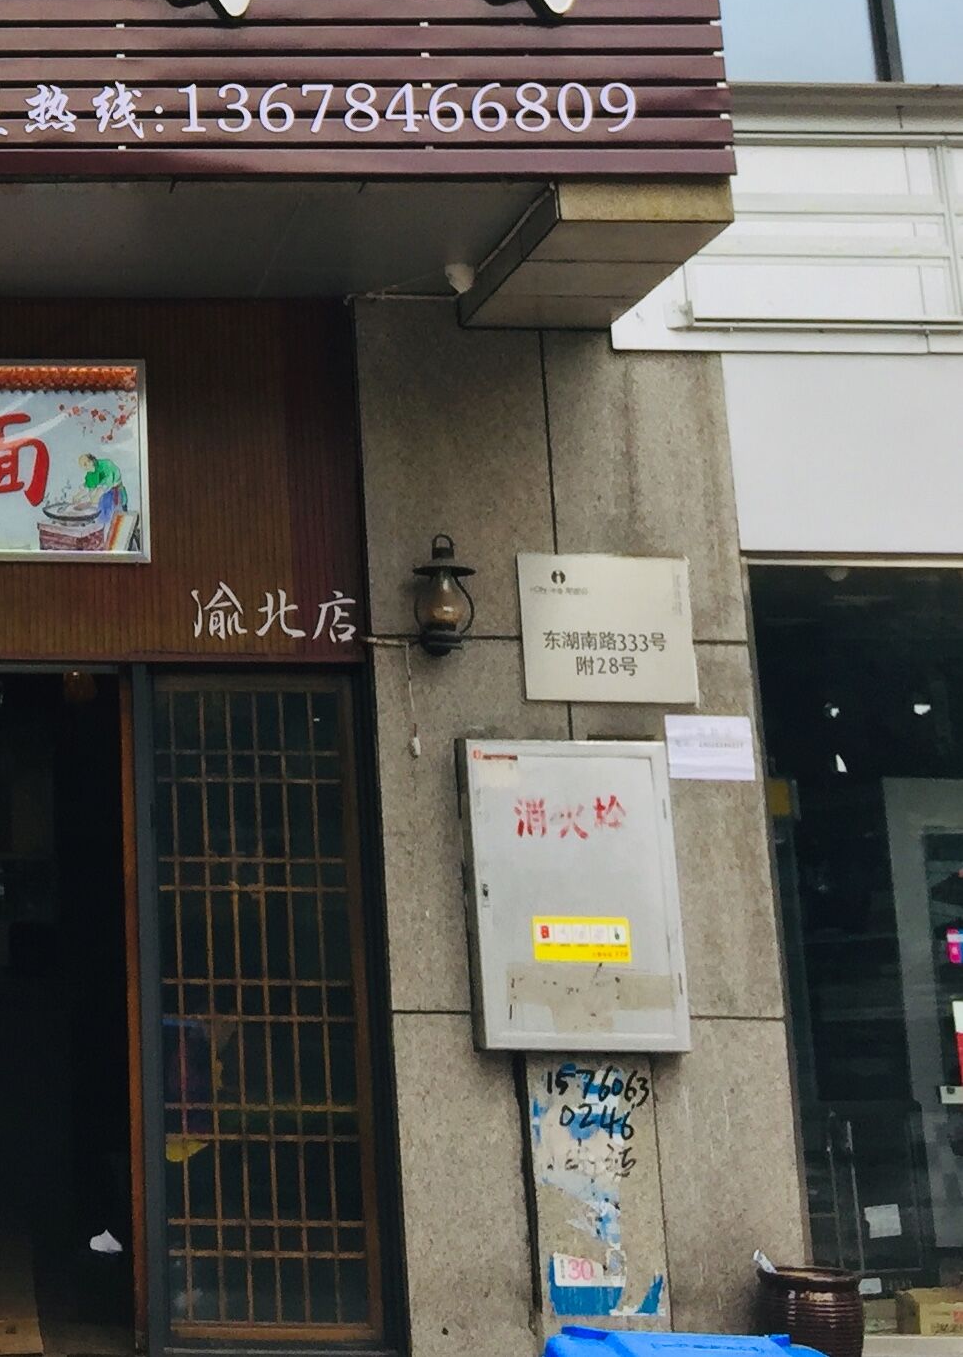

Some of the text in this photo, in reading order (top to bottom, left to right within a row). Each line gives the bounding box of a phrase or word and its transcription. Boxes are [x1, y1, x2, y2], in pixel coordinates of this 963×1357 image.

[191, 581, 357, 643] 渝北店
[543, 630, 667, 653] 东湖南路333号
[576, 656, 638, 677] 附28号
[559, 1102, 636, 1141] 0246
[567, 1258, 595, 1281] 30
